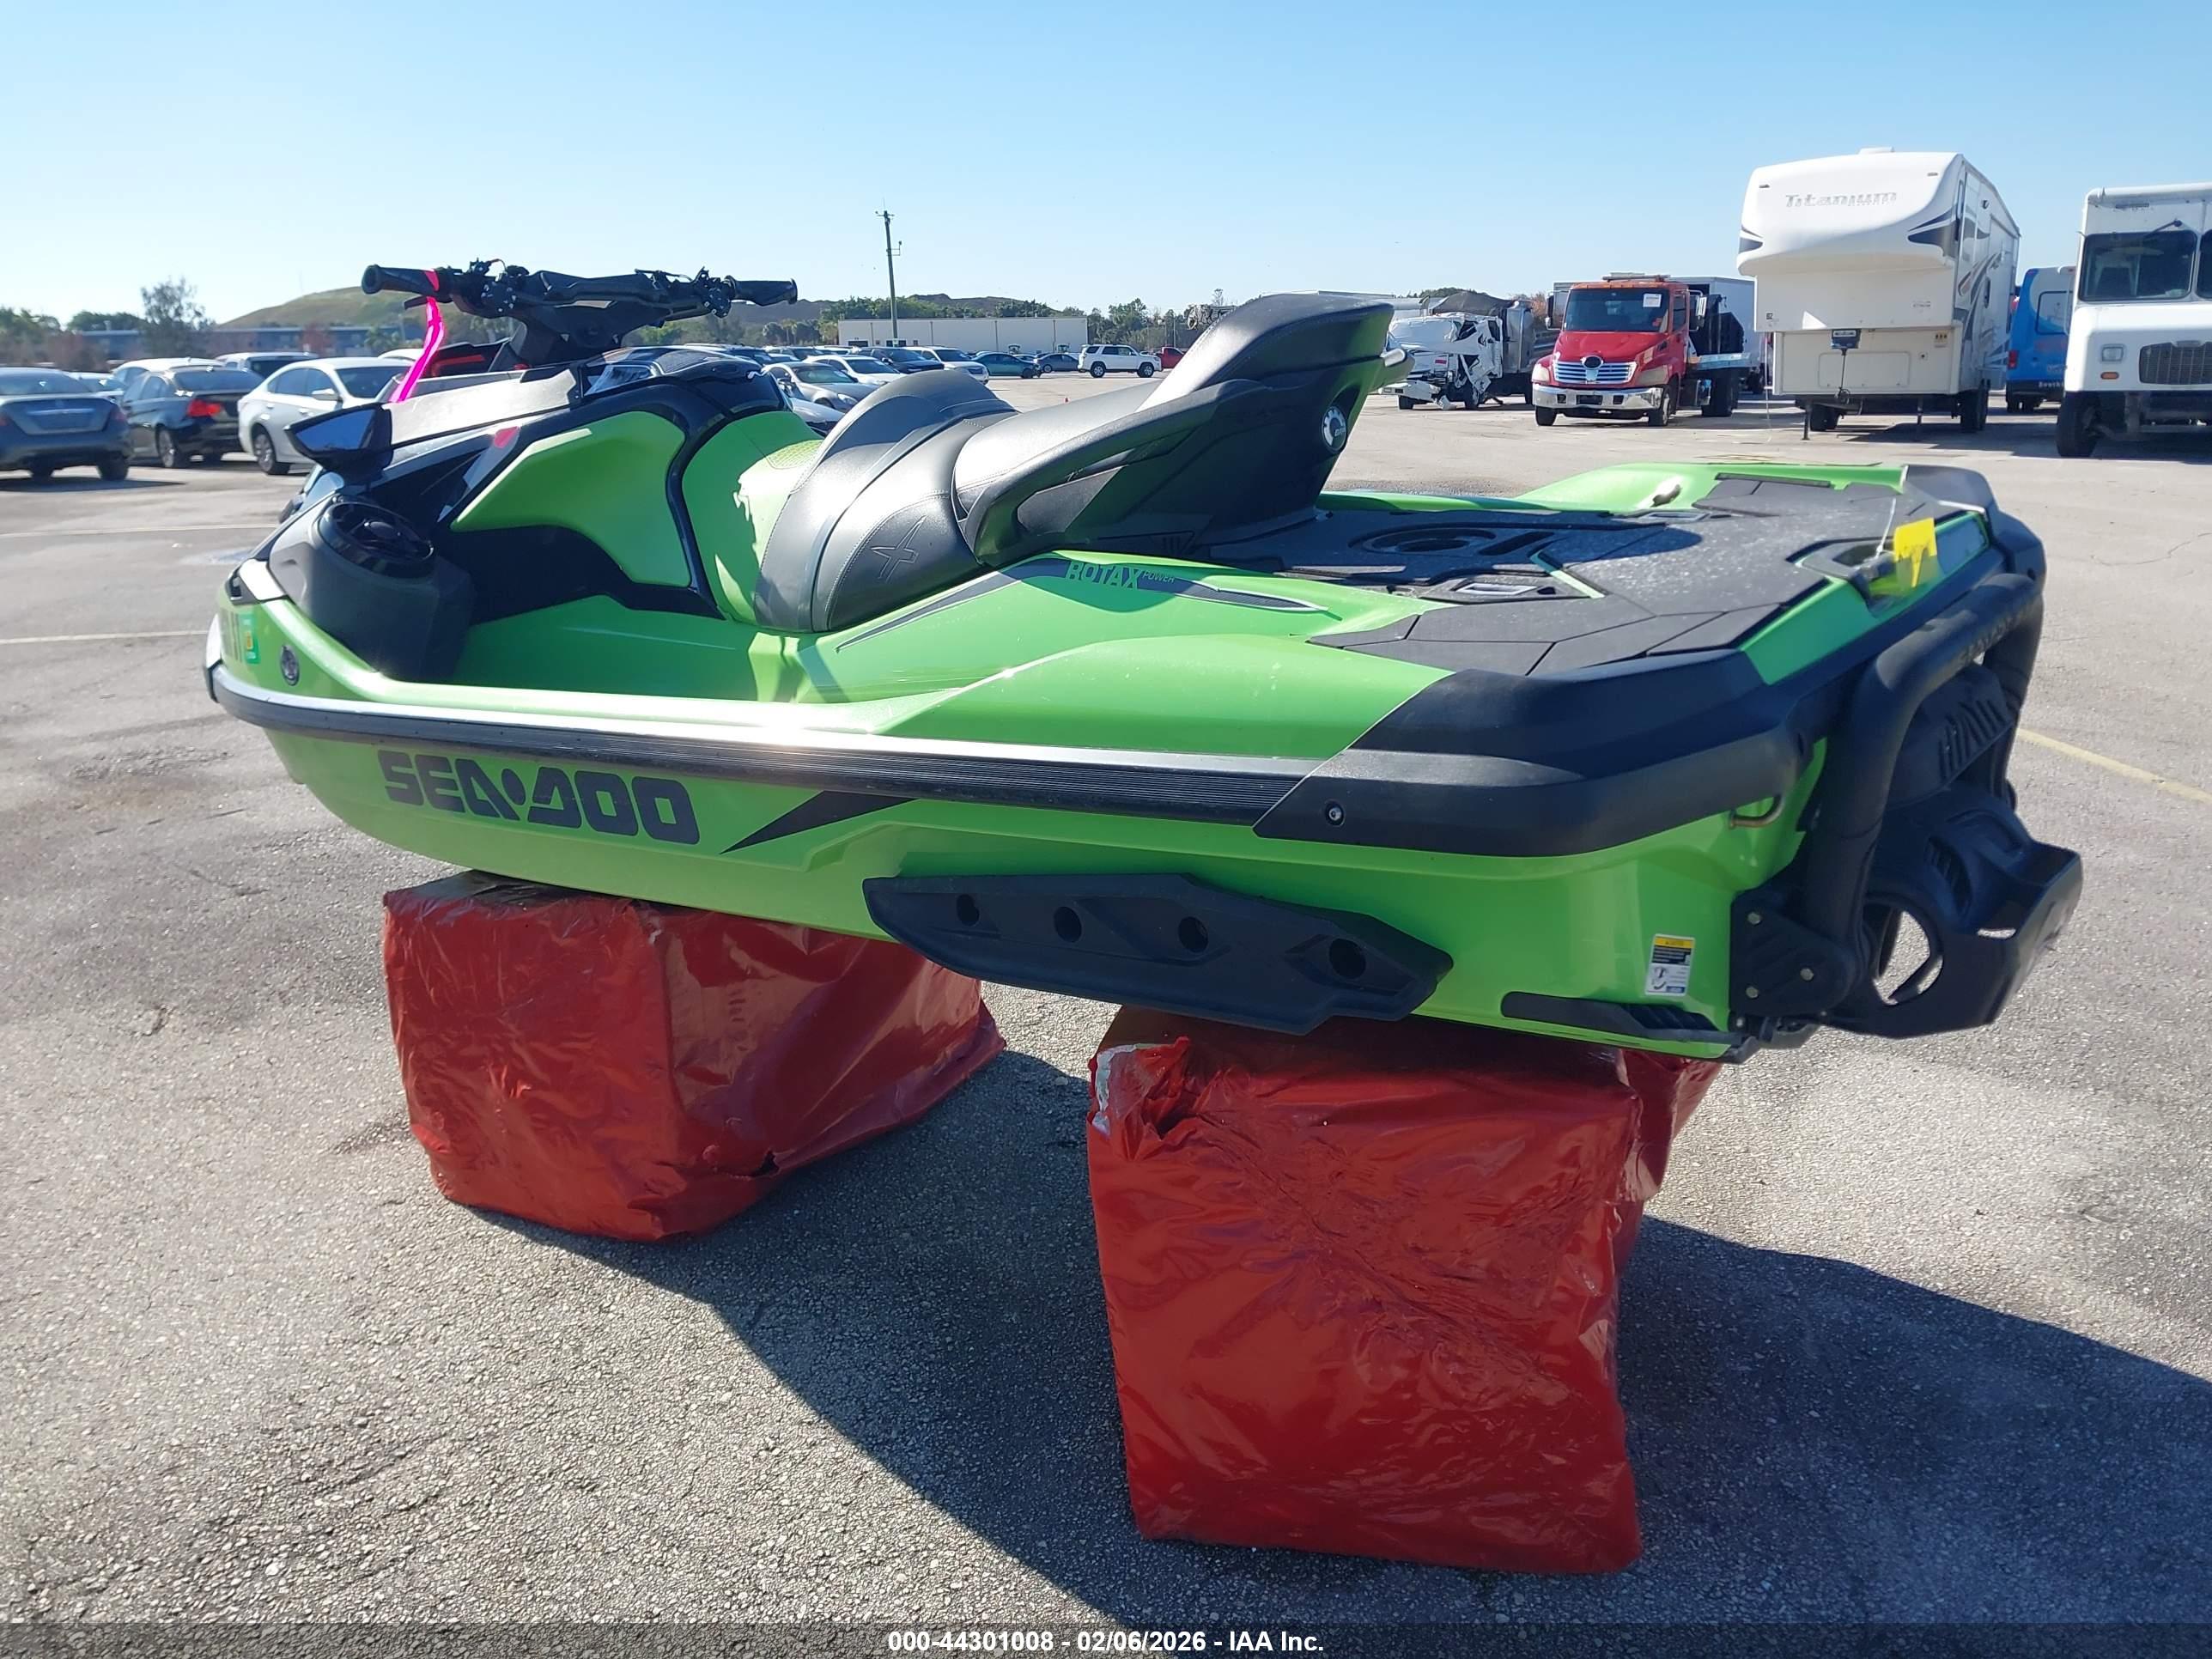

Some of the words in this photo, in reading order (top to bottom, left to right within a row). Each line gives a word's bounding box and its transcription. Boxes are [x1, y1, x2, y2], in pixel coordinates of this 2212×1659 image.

[1785, 191, 1897, 208] Titanium
[1065, 561, 1142, 590] ROTAX
[1142, 569, 1176, 584] POWER
